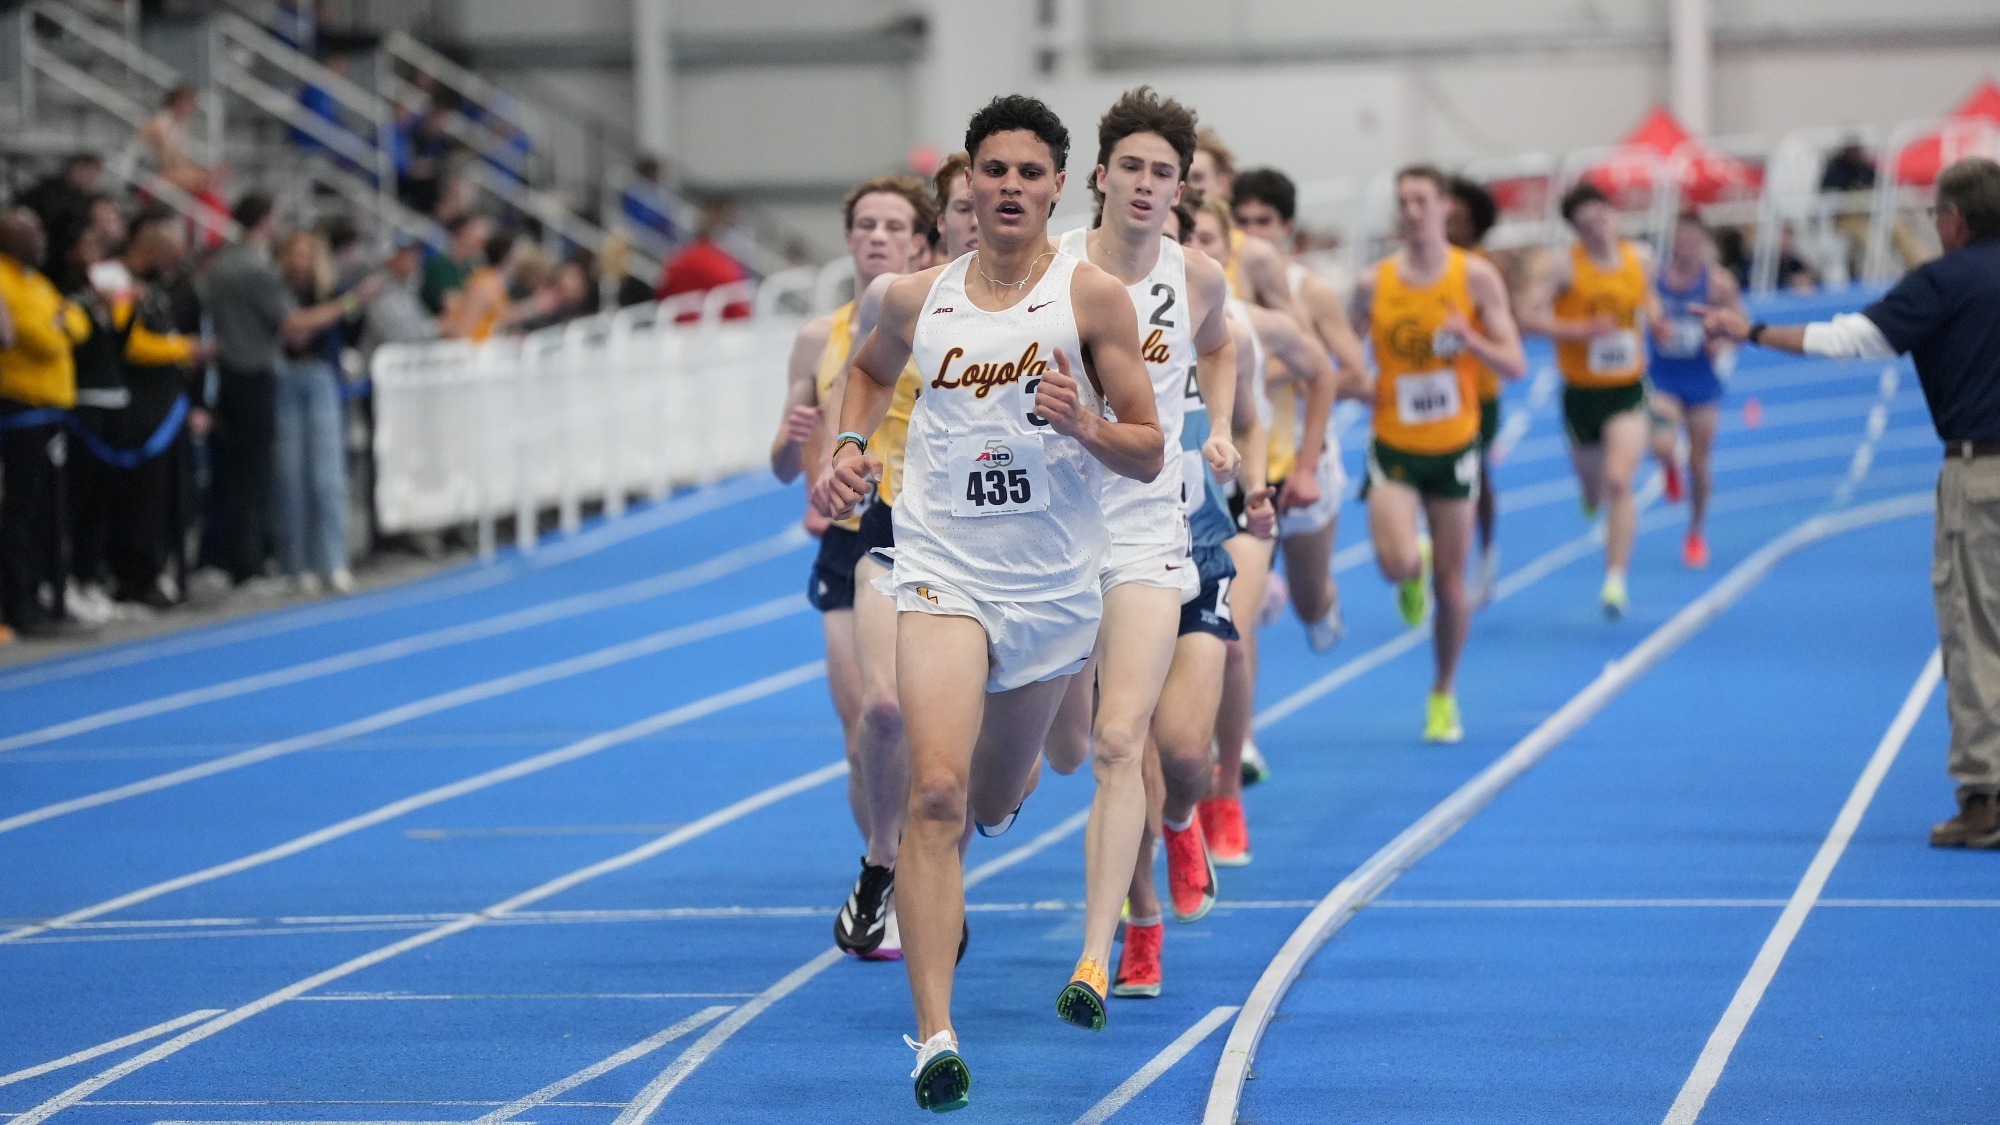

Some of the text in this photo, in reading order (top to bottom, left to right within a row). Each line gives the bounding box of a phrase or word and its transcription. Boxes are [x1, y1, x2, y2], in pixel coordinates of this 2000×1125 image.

[1149, 283, 1176, 328] 2
[930, 340, 1050, 400] Loyola
[966, 468, 1031, 507] 435
